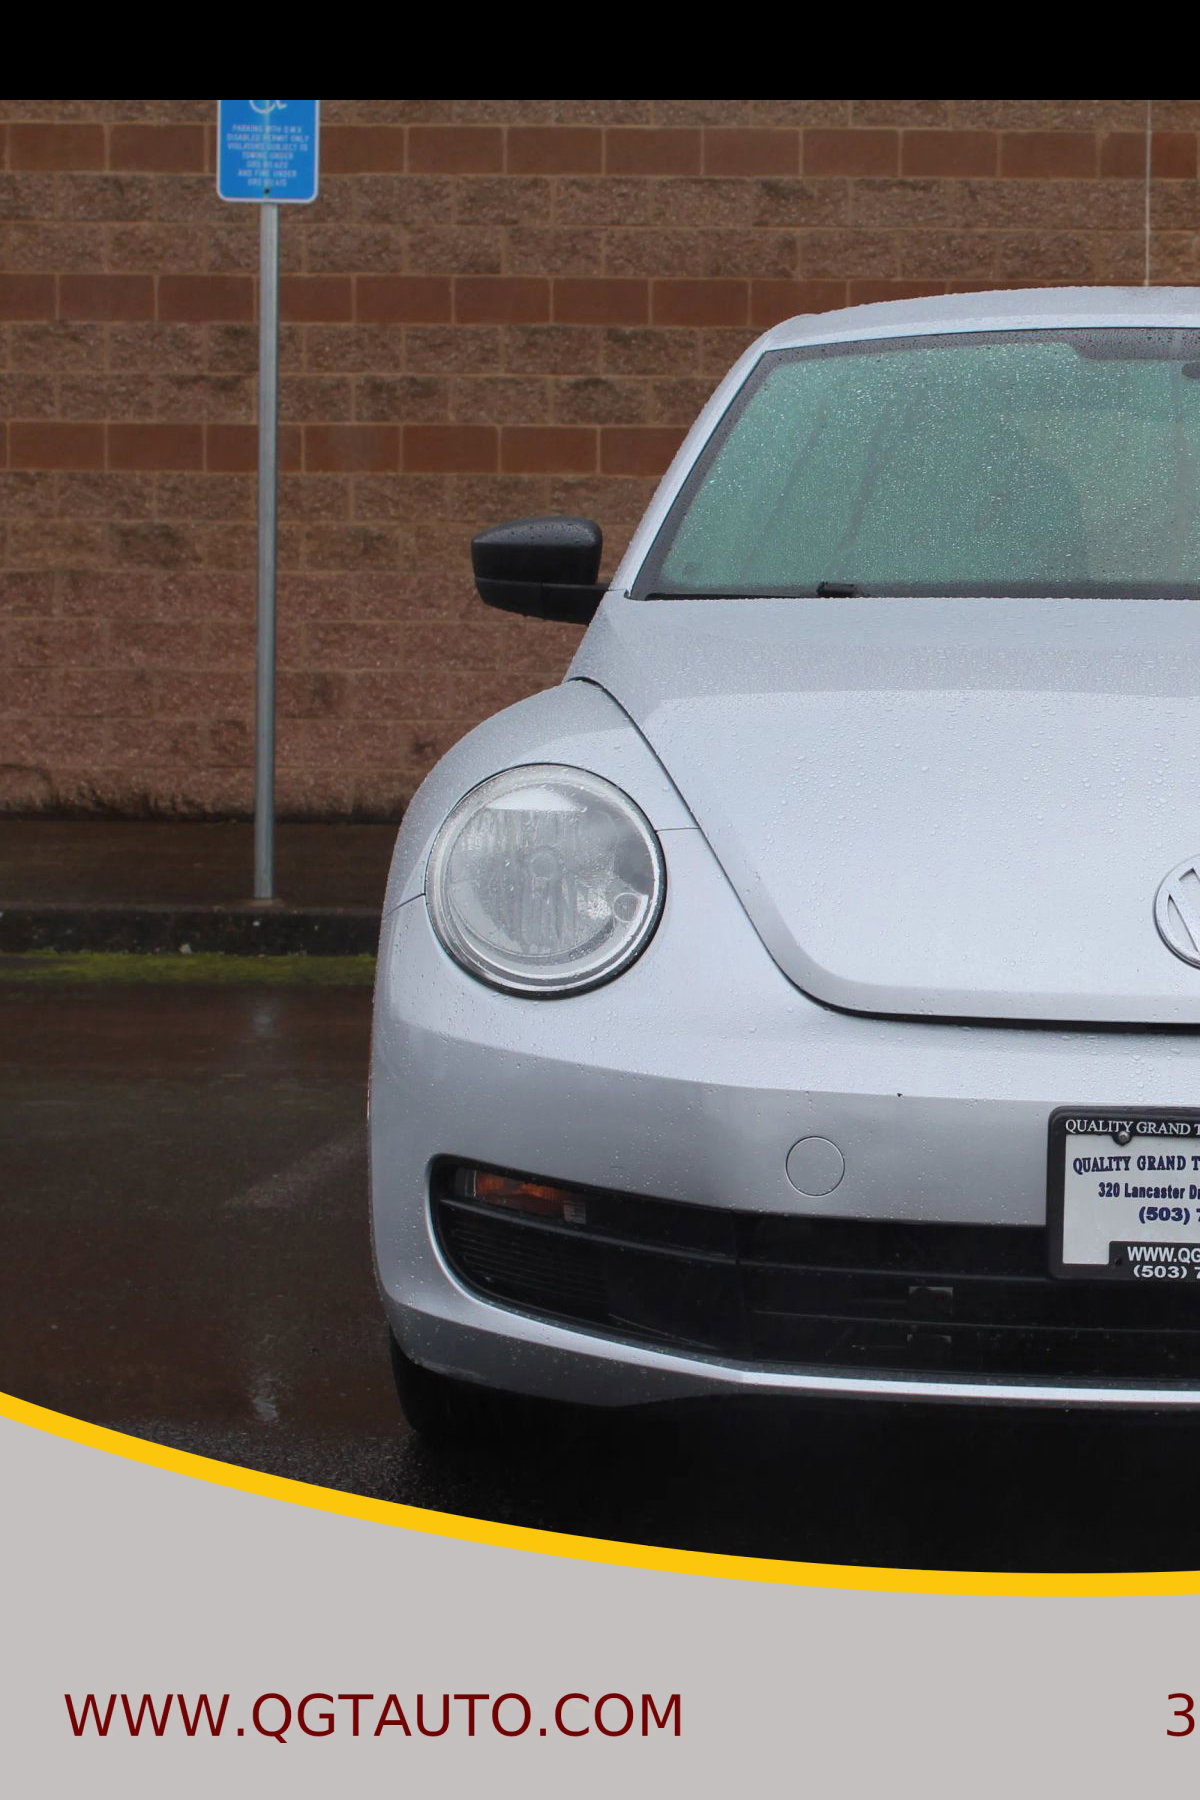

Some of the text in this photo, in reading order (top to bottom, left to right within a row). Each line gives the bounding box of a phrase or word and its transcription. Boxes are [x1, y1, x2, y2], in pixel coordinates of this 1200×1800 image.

[1065, 1120, 1133, 1133] QUALITY
[1136, 1122, 1191, 1135] GRAND
[1073, 1156, 1131, 1175] QUALITY
[1137, 1155, 1186, 1171] GRAND
[1098, 1182, 1120, 1198] 320
[1124, 1183, 1185, 1199] Lancaster
[1139, 1206, 1190, 1225] (503)
[1133, 1264, 1188, 1279] (503)
